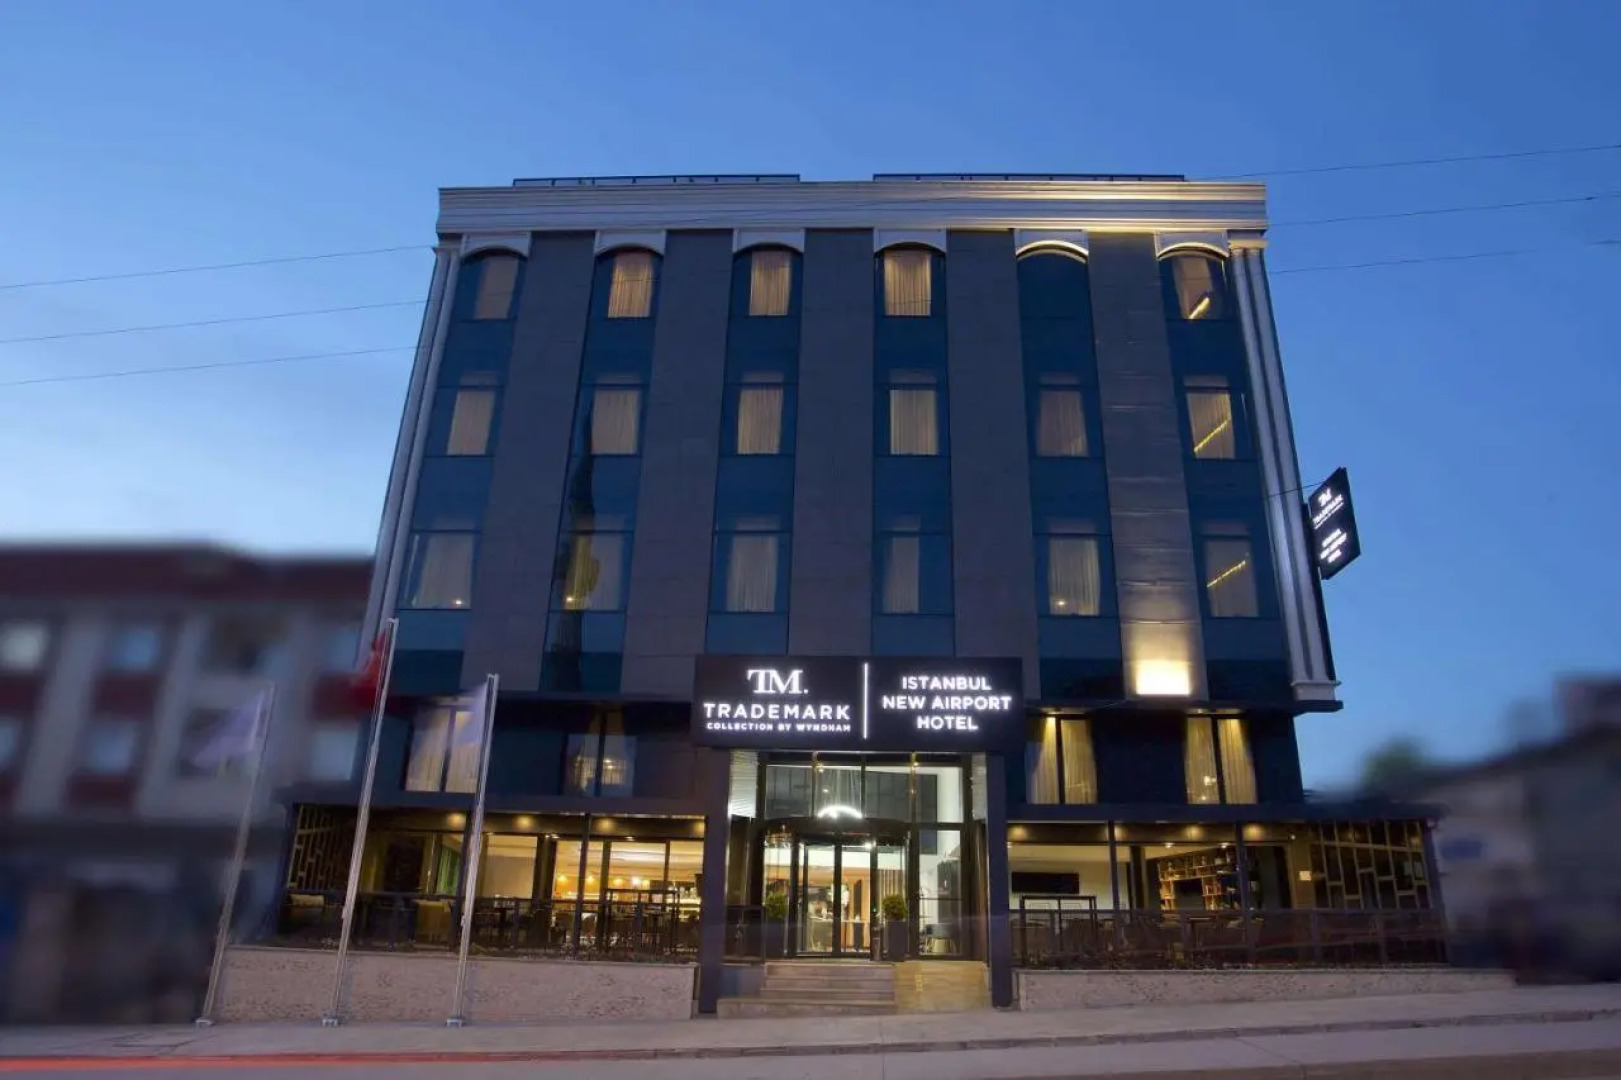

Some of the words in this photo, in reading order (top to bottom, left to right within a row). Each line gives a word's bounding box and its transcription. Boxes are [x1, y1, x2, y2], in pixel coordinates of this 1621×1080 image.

[901, 675, 992, 692] ISTANBUL
[703, 702, 851, 720] TRADEMARK
[882, 695, 926, 711] NEW
[931, 695, 1012, 711] AIRPORT
[706, 722, 773, 732] COLLECTION
[777, 722, 792, 733] BY
[795, 722, 851, 733] WYNDHAM
[916, 714, 979, 731] HOTEL
